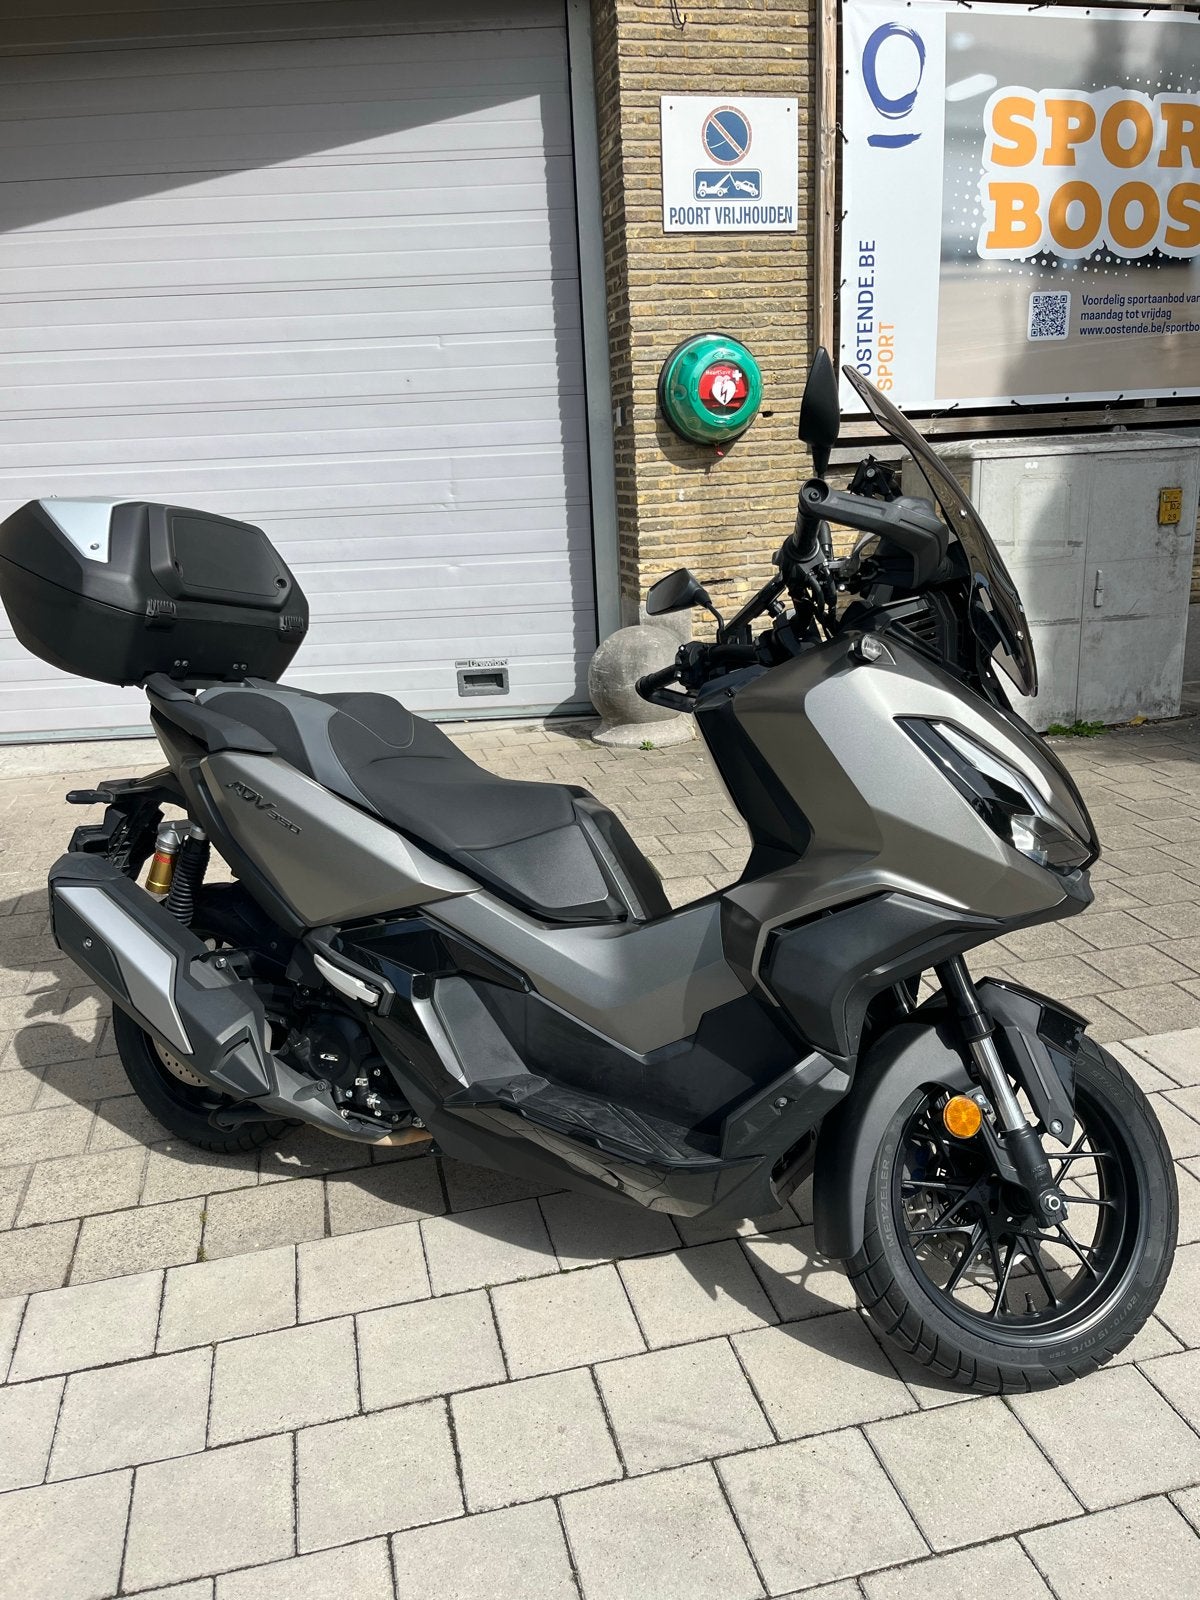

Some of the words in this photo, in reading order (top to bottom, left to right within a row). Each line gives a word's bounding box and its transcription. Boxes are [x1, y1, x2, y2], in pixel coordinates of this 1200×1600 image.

[990, 96, 1200, 168] SPOR
[669, 206, 711, 225] POORT
[714, 205, 793, 225] VRIJHOUDEN
[985, 180, 1200, 249] BOOS
[856, 240, 876, 378] OSTENDE.BE
[1079, 321, 1200, 335] www.oostende.be/sportbo
[1080, 309, 1124, 321] maandag
[1125, 309, 1140, 319] tot
[1141, 307, 1172, 320] vrijdag
[1082, 294, 1125, 306] Voordelig
[1127, 292, 1185, 306] sportaanbod
[876, 321, 895, 391] SPORT
[880, 1159, 895, 1248] METZELER
